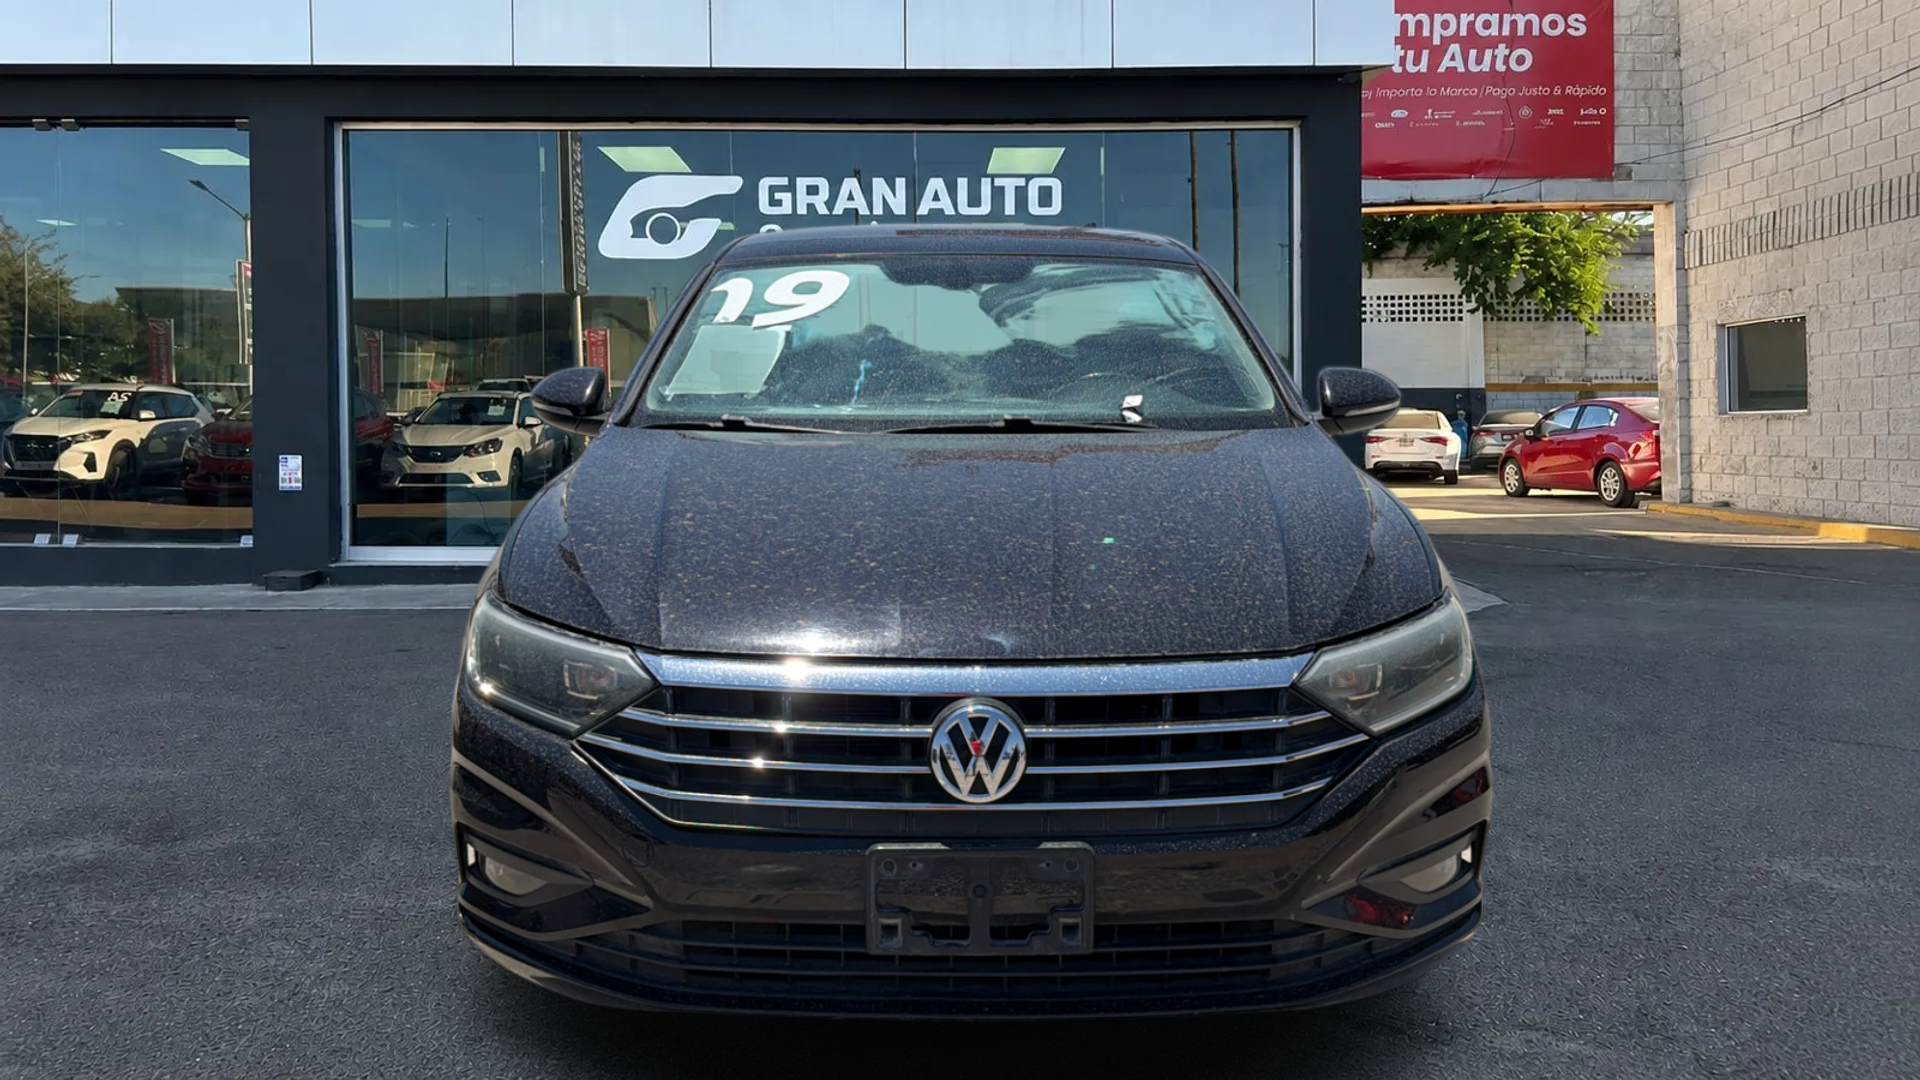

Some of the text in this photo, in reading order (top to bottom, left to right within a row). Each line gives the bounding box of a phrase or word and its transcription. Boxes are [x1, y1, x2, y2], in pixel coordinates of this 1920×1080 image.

[1392, 43, 1533, 73] tu Auto
[1375, 87, 1423, 99] Importa
[1440, 86, 1478, 96] Marca
[1519, 85, 1551, 96] Justo
[1553, 86, 1561, 96] &
[1565, 83, 1607, 98] Rápido
[758, 176, 1063, 216] GRAN AUTO
[711, 270, 850, 328] 19
